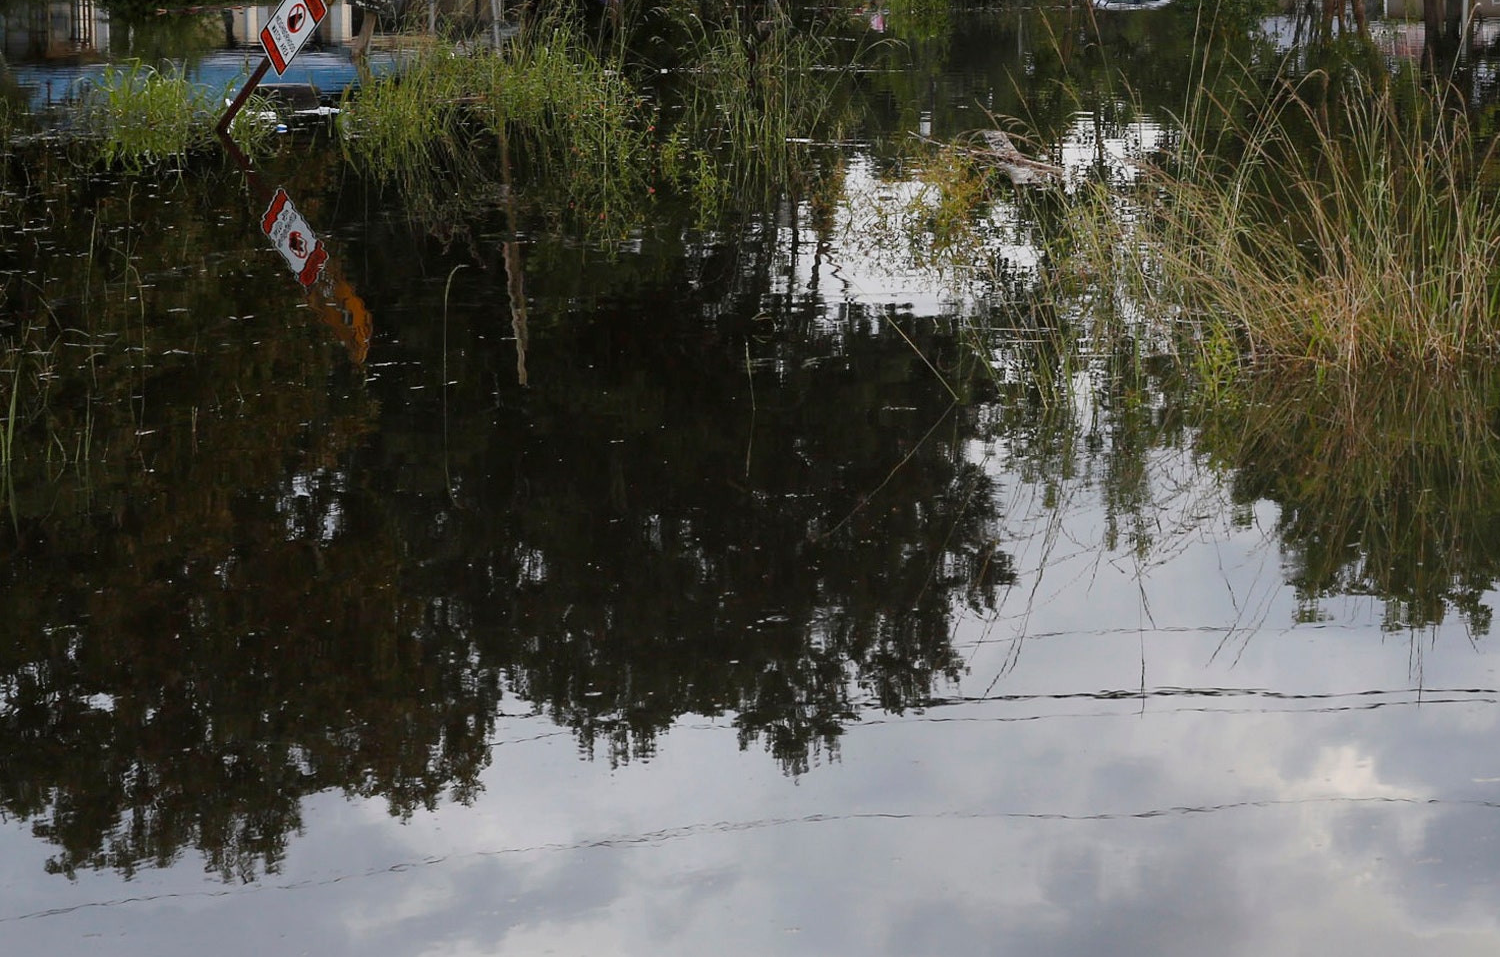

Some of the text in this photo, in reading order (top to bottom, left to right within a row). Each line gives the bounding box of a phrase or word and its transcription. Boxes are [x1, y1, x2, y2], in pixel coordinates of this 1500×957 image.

[271, 25, 281, 42] WATCH
[279, 43, 289, 56] AREA
[275, 14, 296, 53] NEIGHBORHOOD
